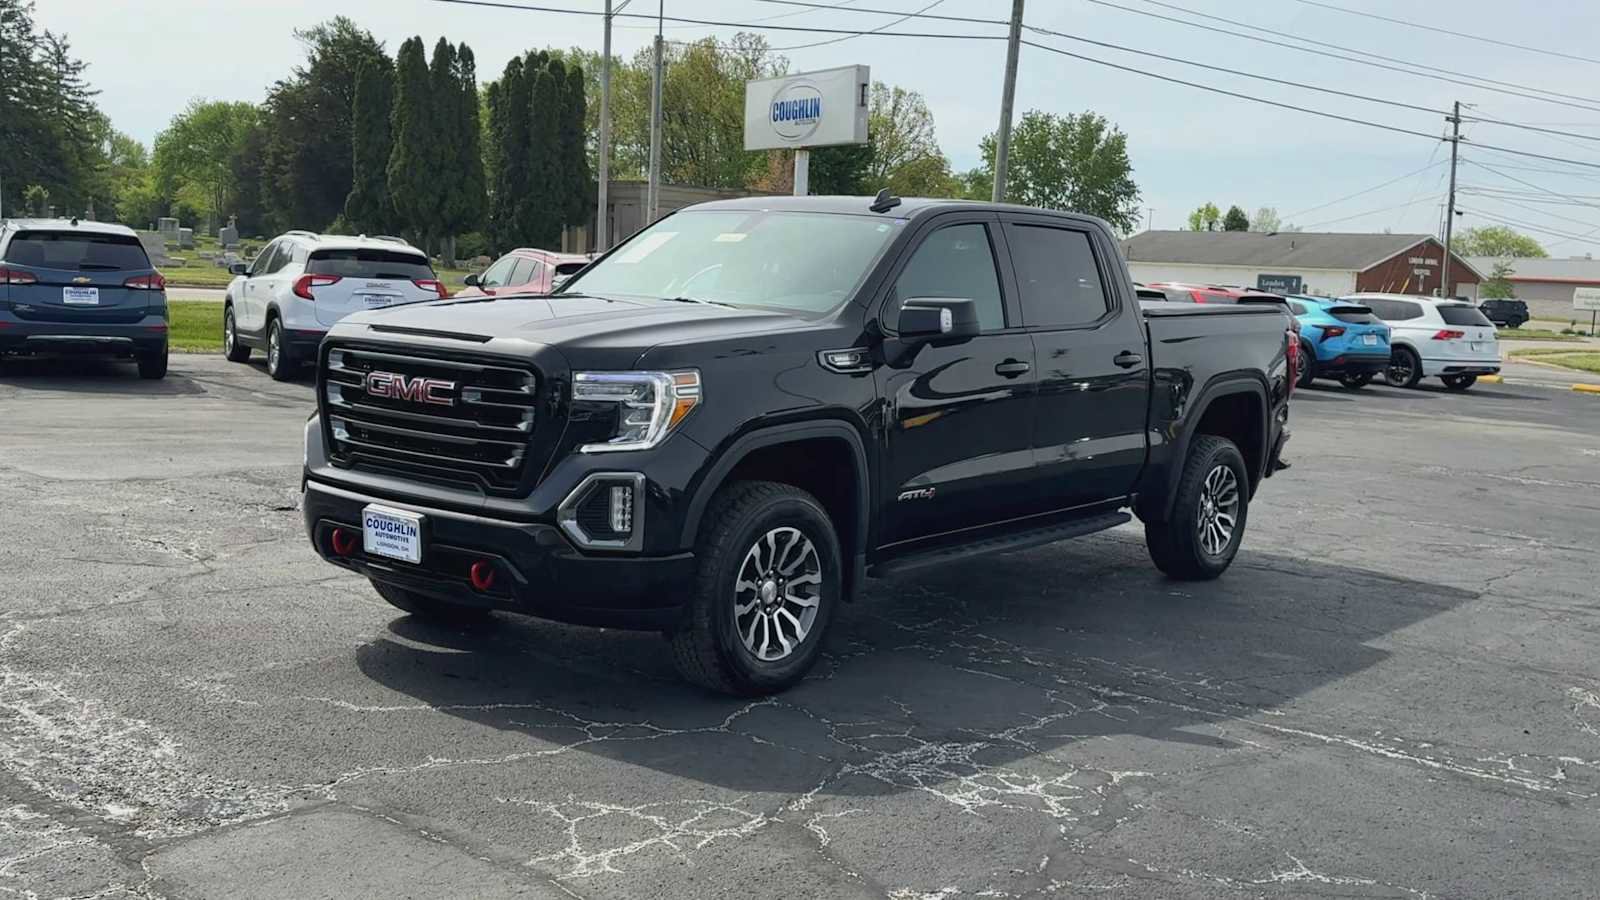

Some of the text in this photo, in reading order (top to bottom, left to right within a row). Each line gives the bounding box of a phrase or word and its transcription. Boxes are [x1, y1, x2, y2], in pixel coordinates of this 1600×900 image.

[772, 97, 821, 122] COUGHLIN
[366, 370, 455, 407] GMC
[898, 487, 936, 501] AT4
[366, 518, 417, 537] COUGHLIN
[375, 531, 410, 544] AUTOMOTIVE
